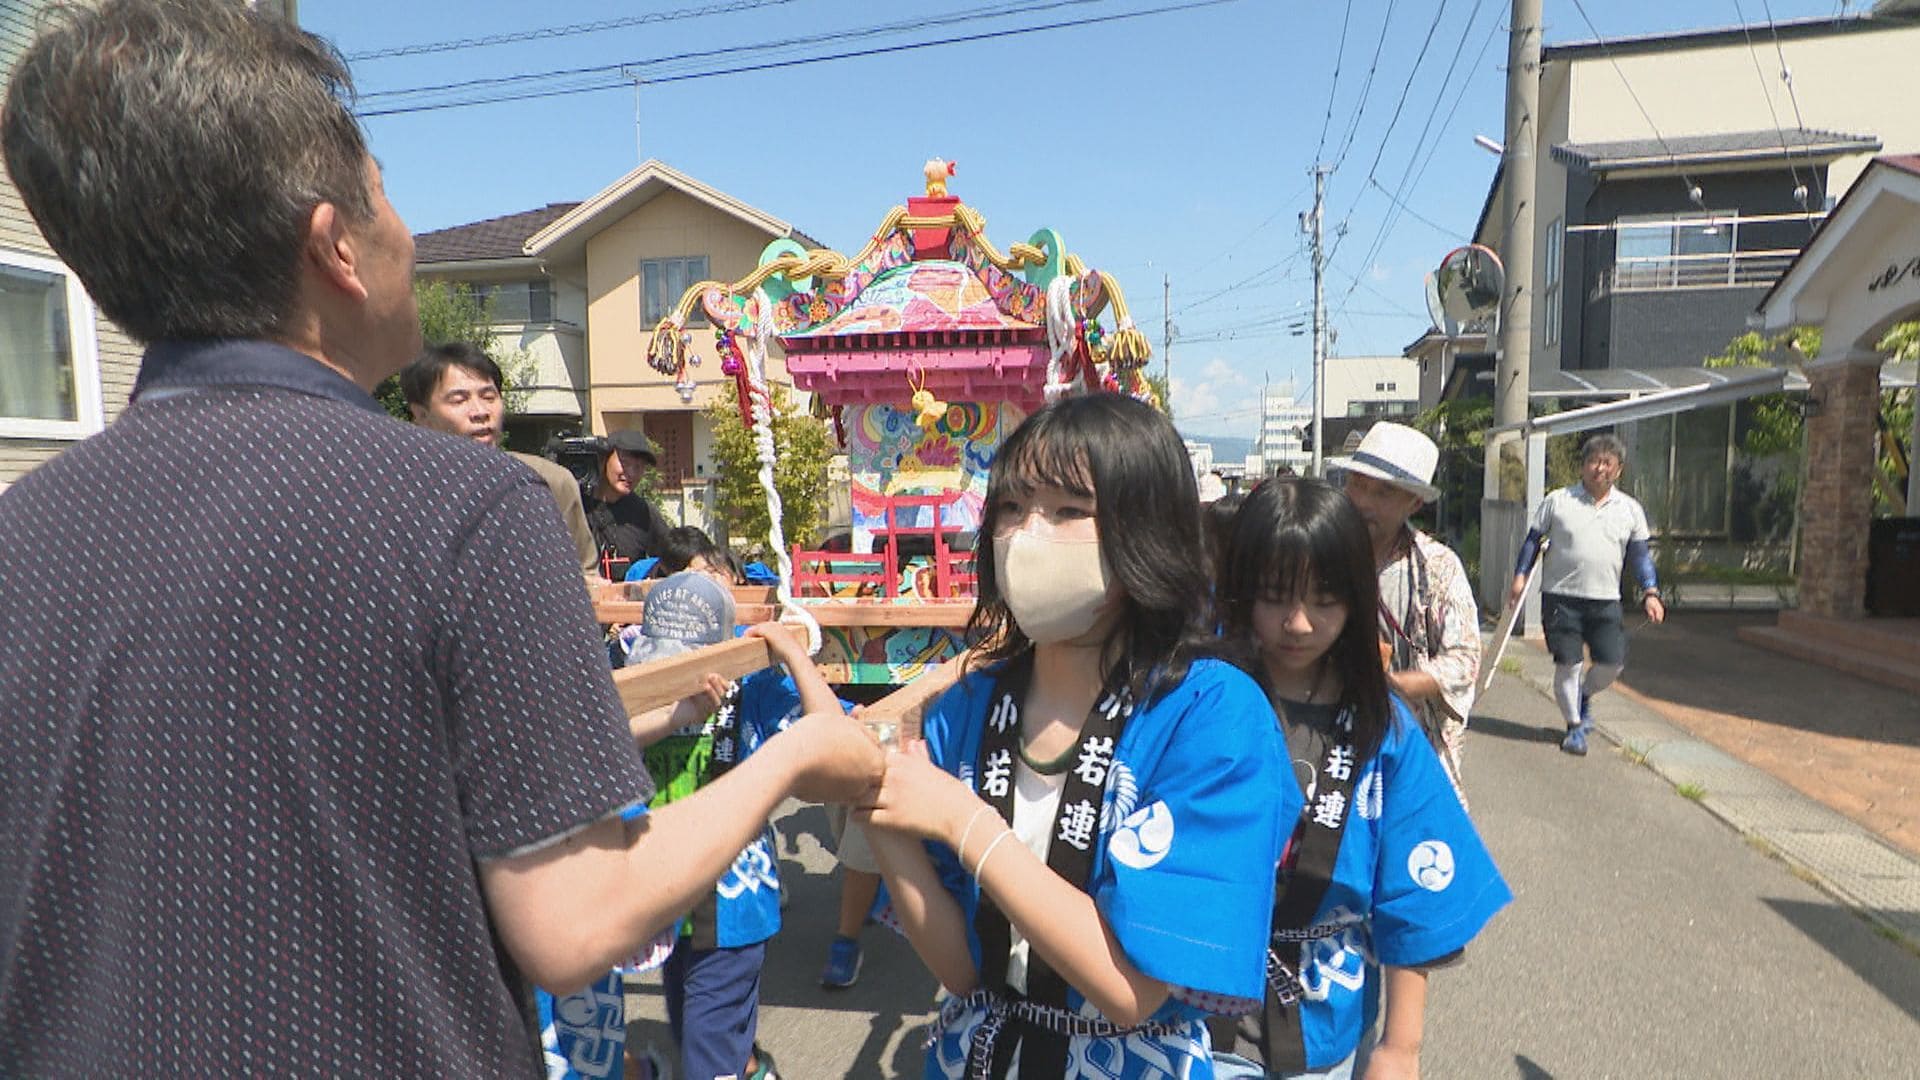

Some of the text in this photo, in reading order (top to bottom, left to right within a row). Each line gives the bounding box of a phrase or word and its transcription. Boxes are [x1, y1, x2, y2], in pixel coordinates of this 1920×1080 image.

[983, 694, 1018, 797] 小若
[1058, 685, 1133, 851] 小若連
